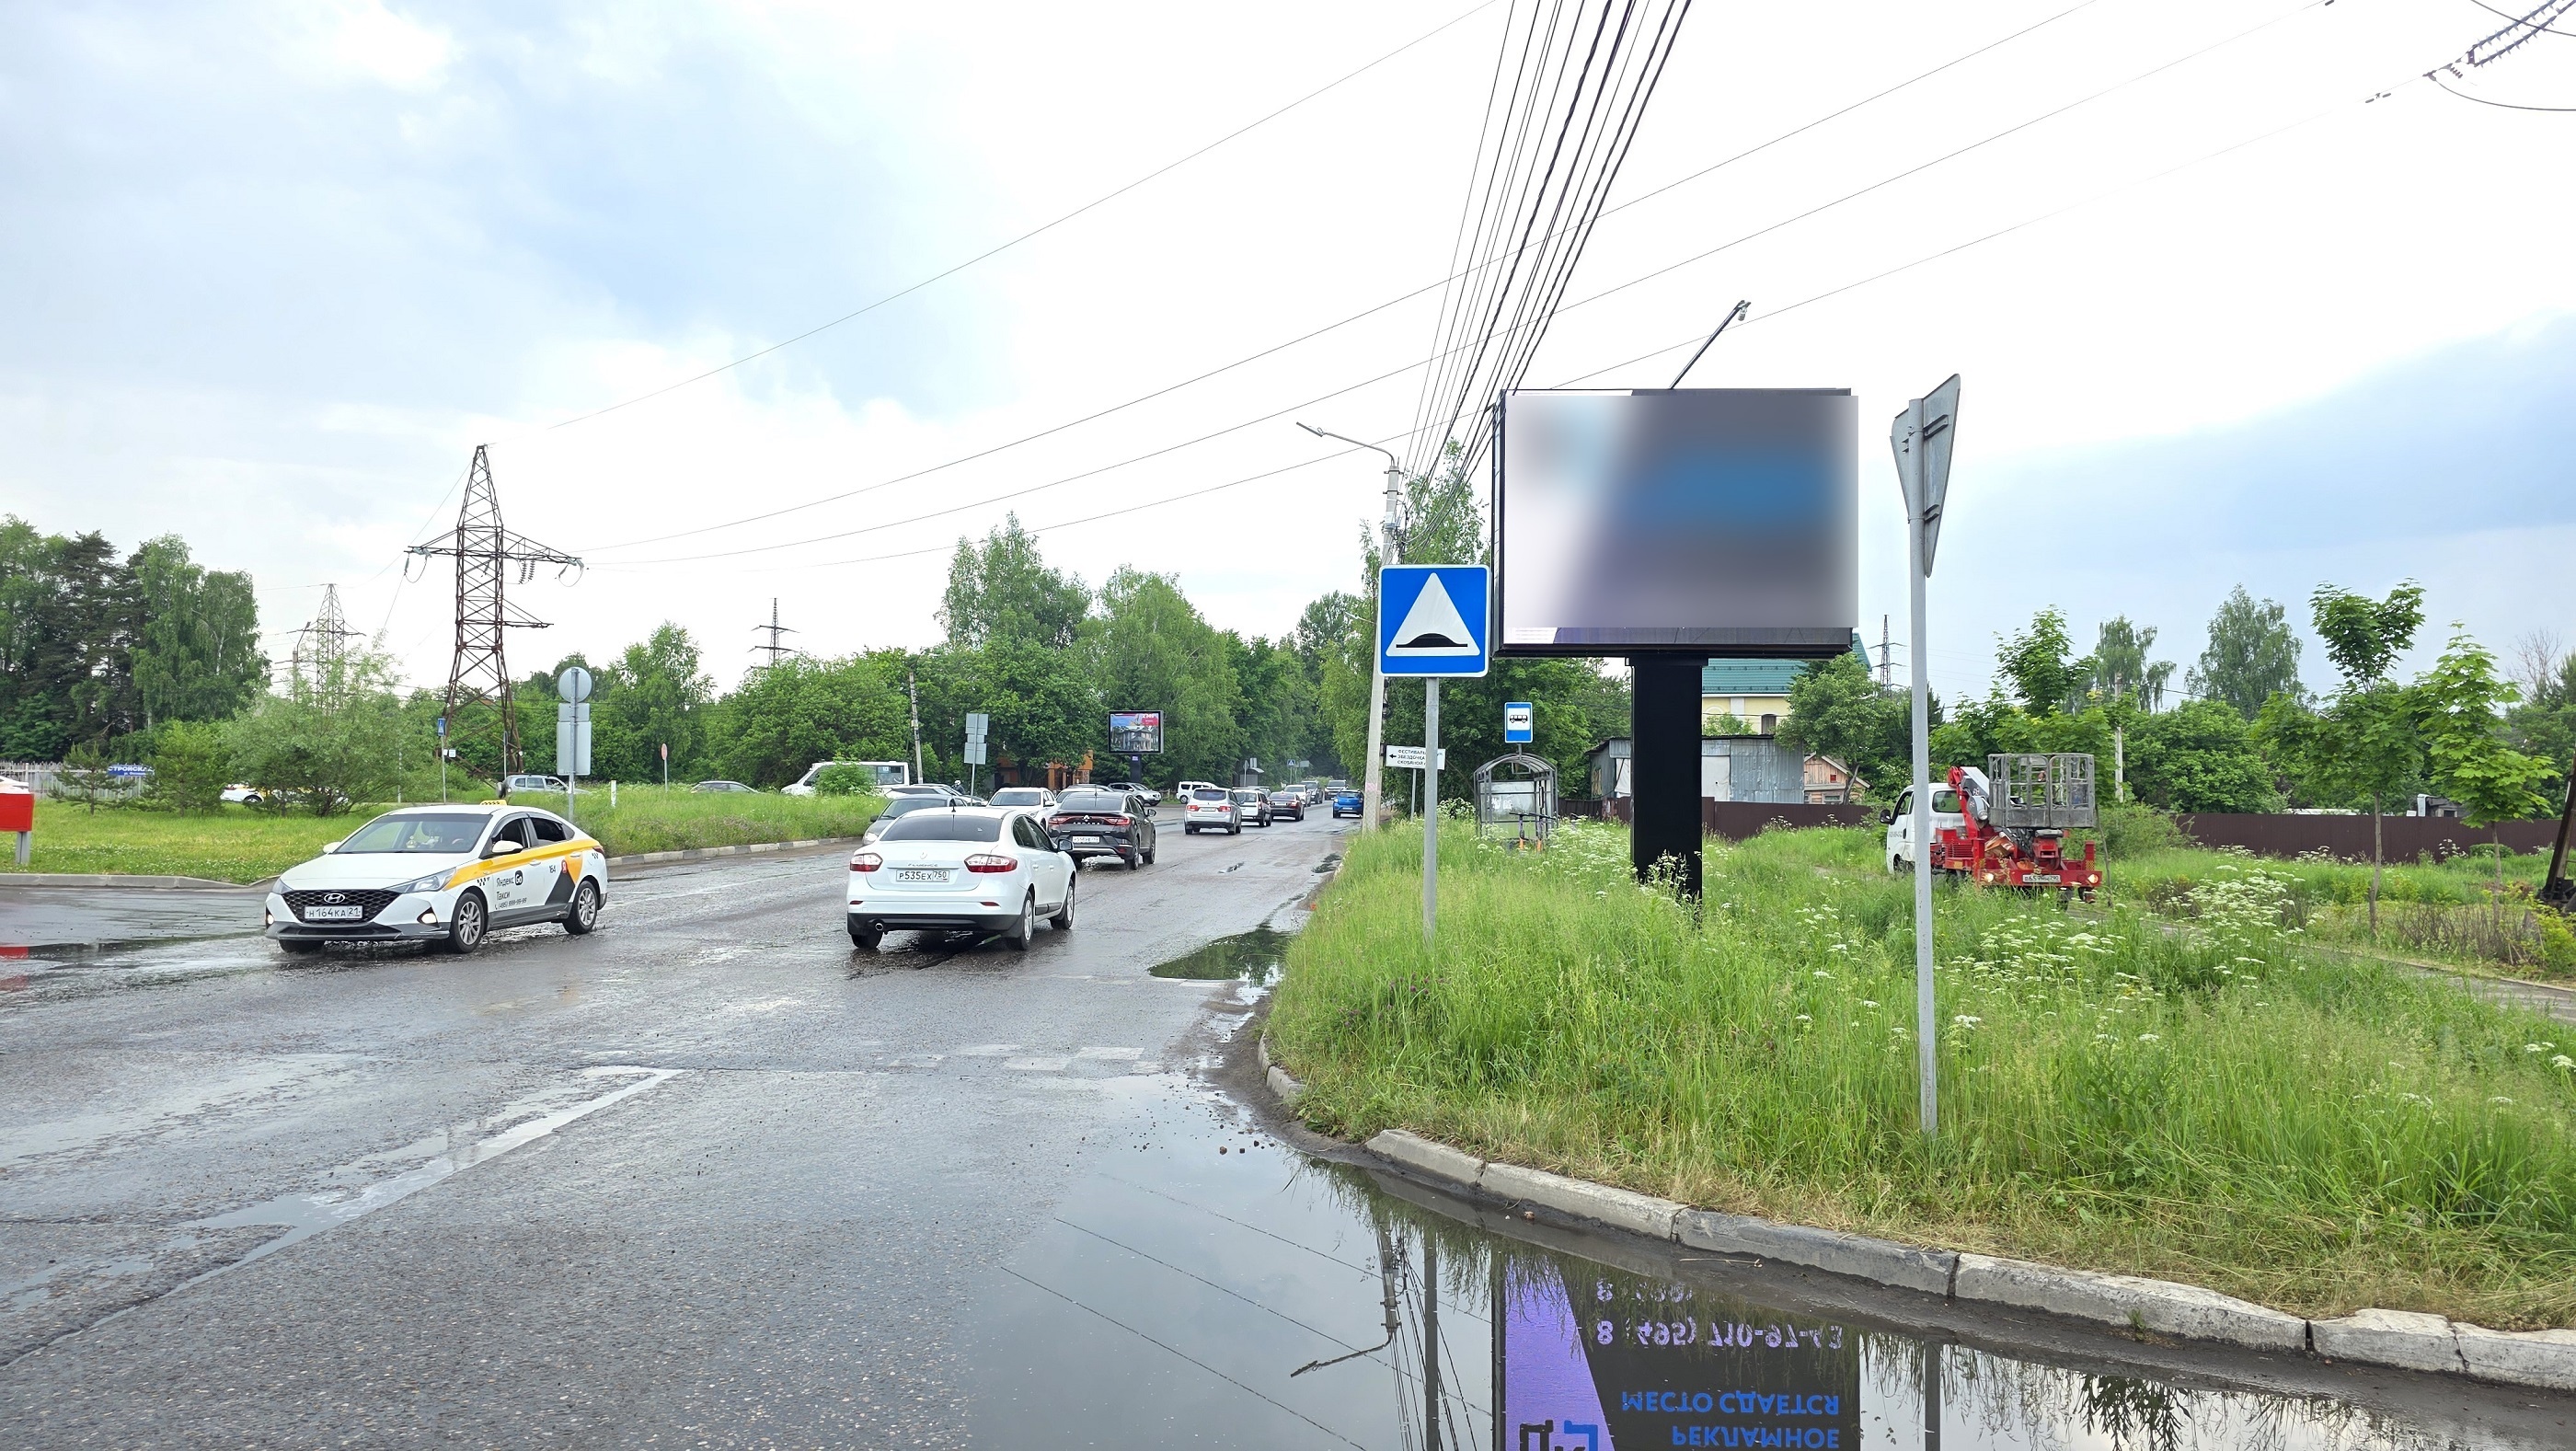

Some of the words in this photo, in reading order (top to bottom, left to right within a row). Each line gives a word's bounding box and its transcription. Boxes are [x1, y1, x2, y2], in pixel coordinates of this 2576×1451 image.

[497, 877, 514, 887] Яндекс
[497, 892, 510, 901] Такси
[308, 908, 346, 917] Н164КА
